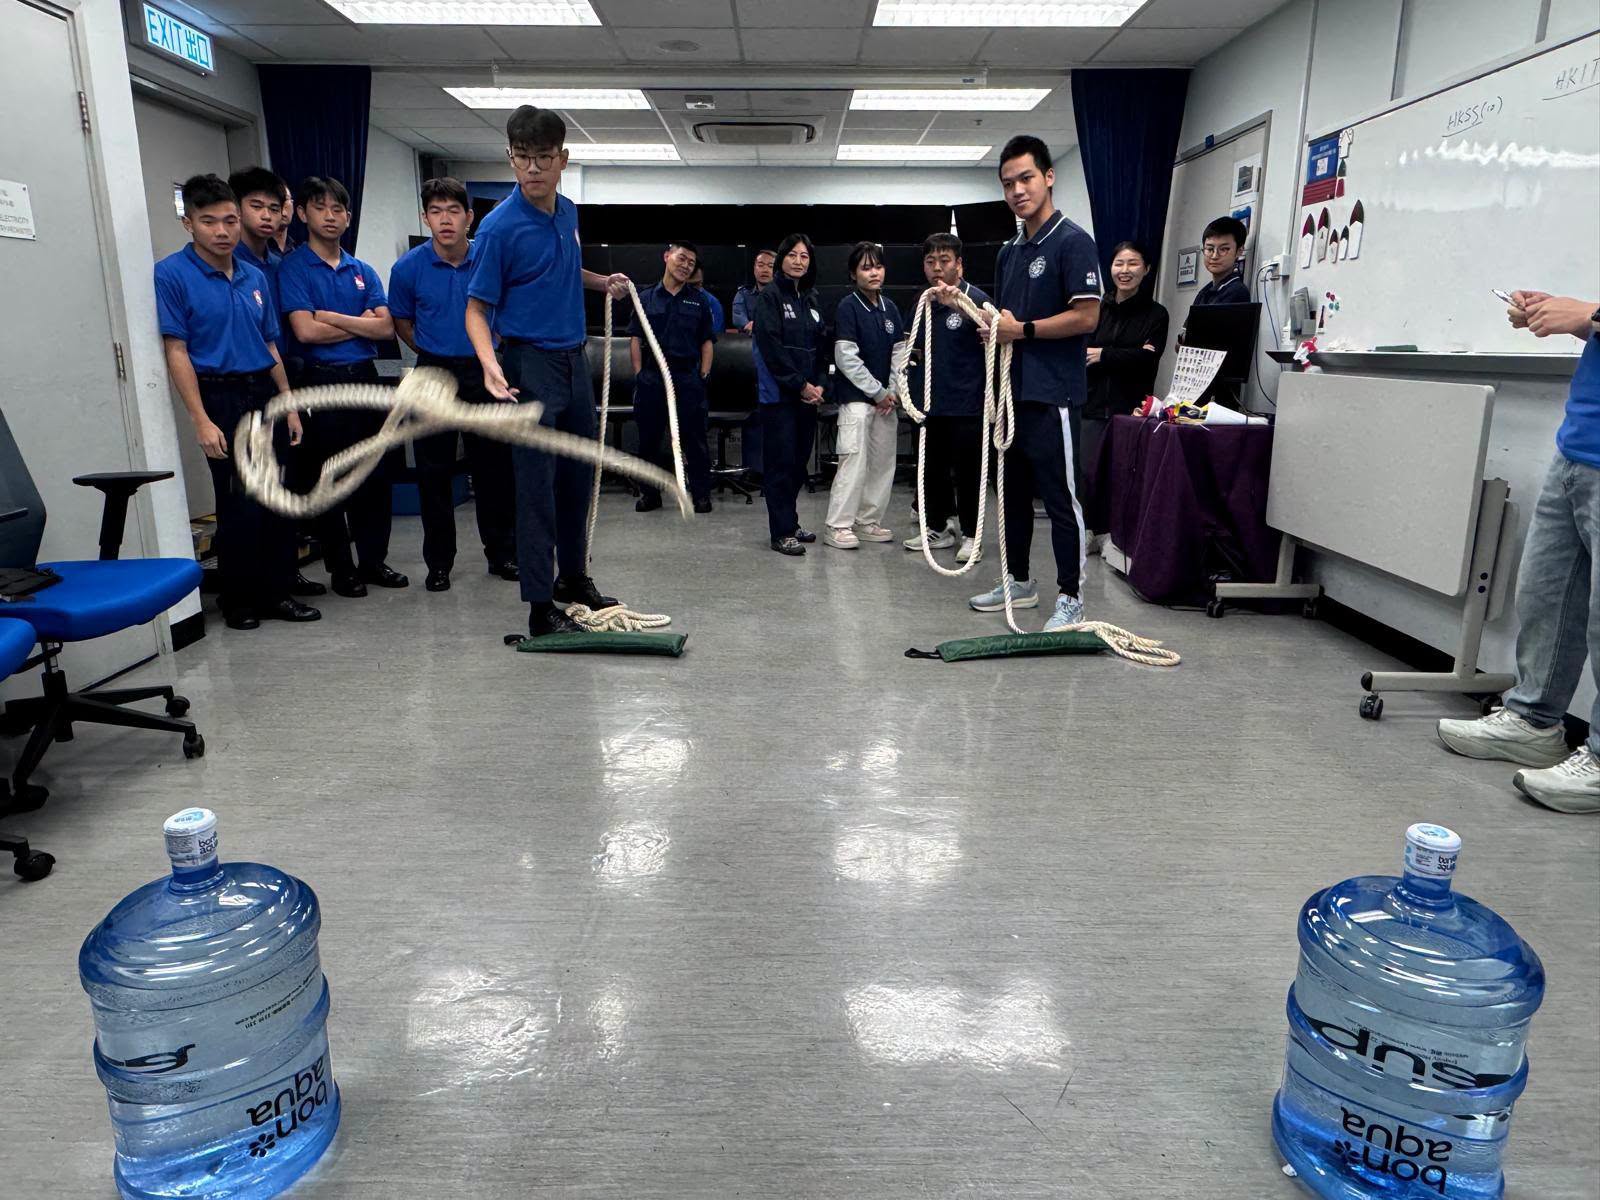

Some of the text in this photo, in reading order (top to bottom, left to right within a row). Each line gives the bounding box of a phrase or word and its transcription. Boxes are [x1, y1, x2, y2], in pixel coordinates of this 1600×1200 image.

[147, 9, 209, 67] EXIT 出口
[246, 1056, 325, 1128] aqua
[275, 1080, 328, 1139] bon
[1340, 1106, 1453, 1163] aqua
[1362, 1146, 1447, 1194] bon
